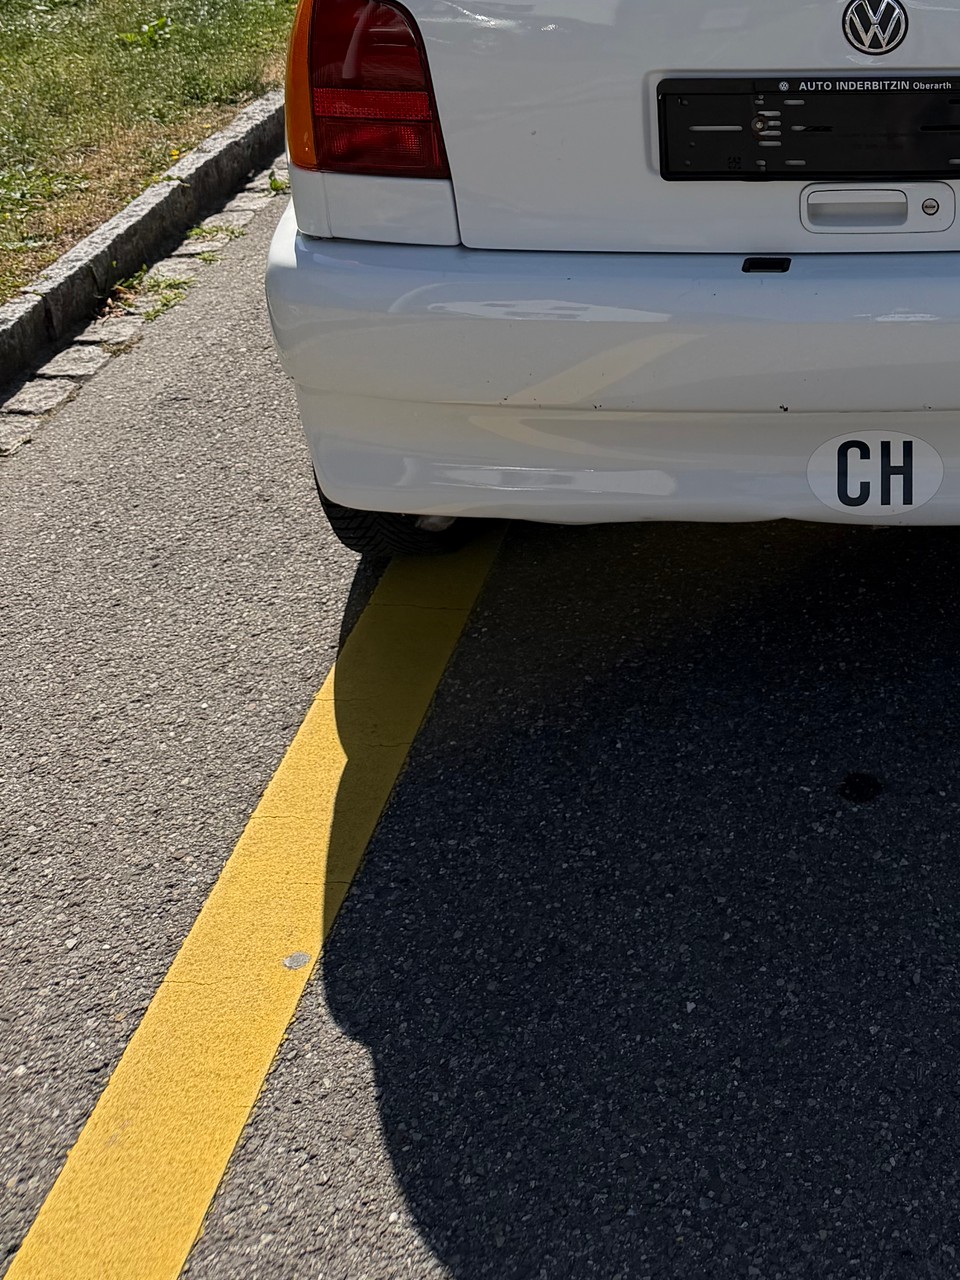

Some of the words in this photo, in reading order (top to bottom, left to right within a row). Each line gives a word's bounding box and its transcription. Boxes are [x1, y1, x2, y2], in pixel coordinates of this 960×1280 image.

[799, 81, 832, 90] AUTO
[836, 81, 909, 90] INDERBITZIN
[913, 82, 952, 90] Oberarth
[837, 440, 913, 507] CH
